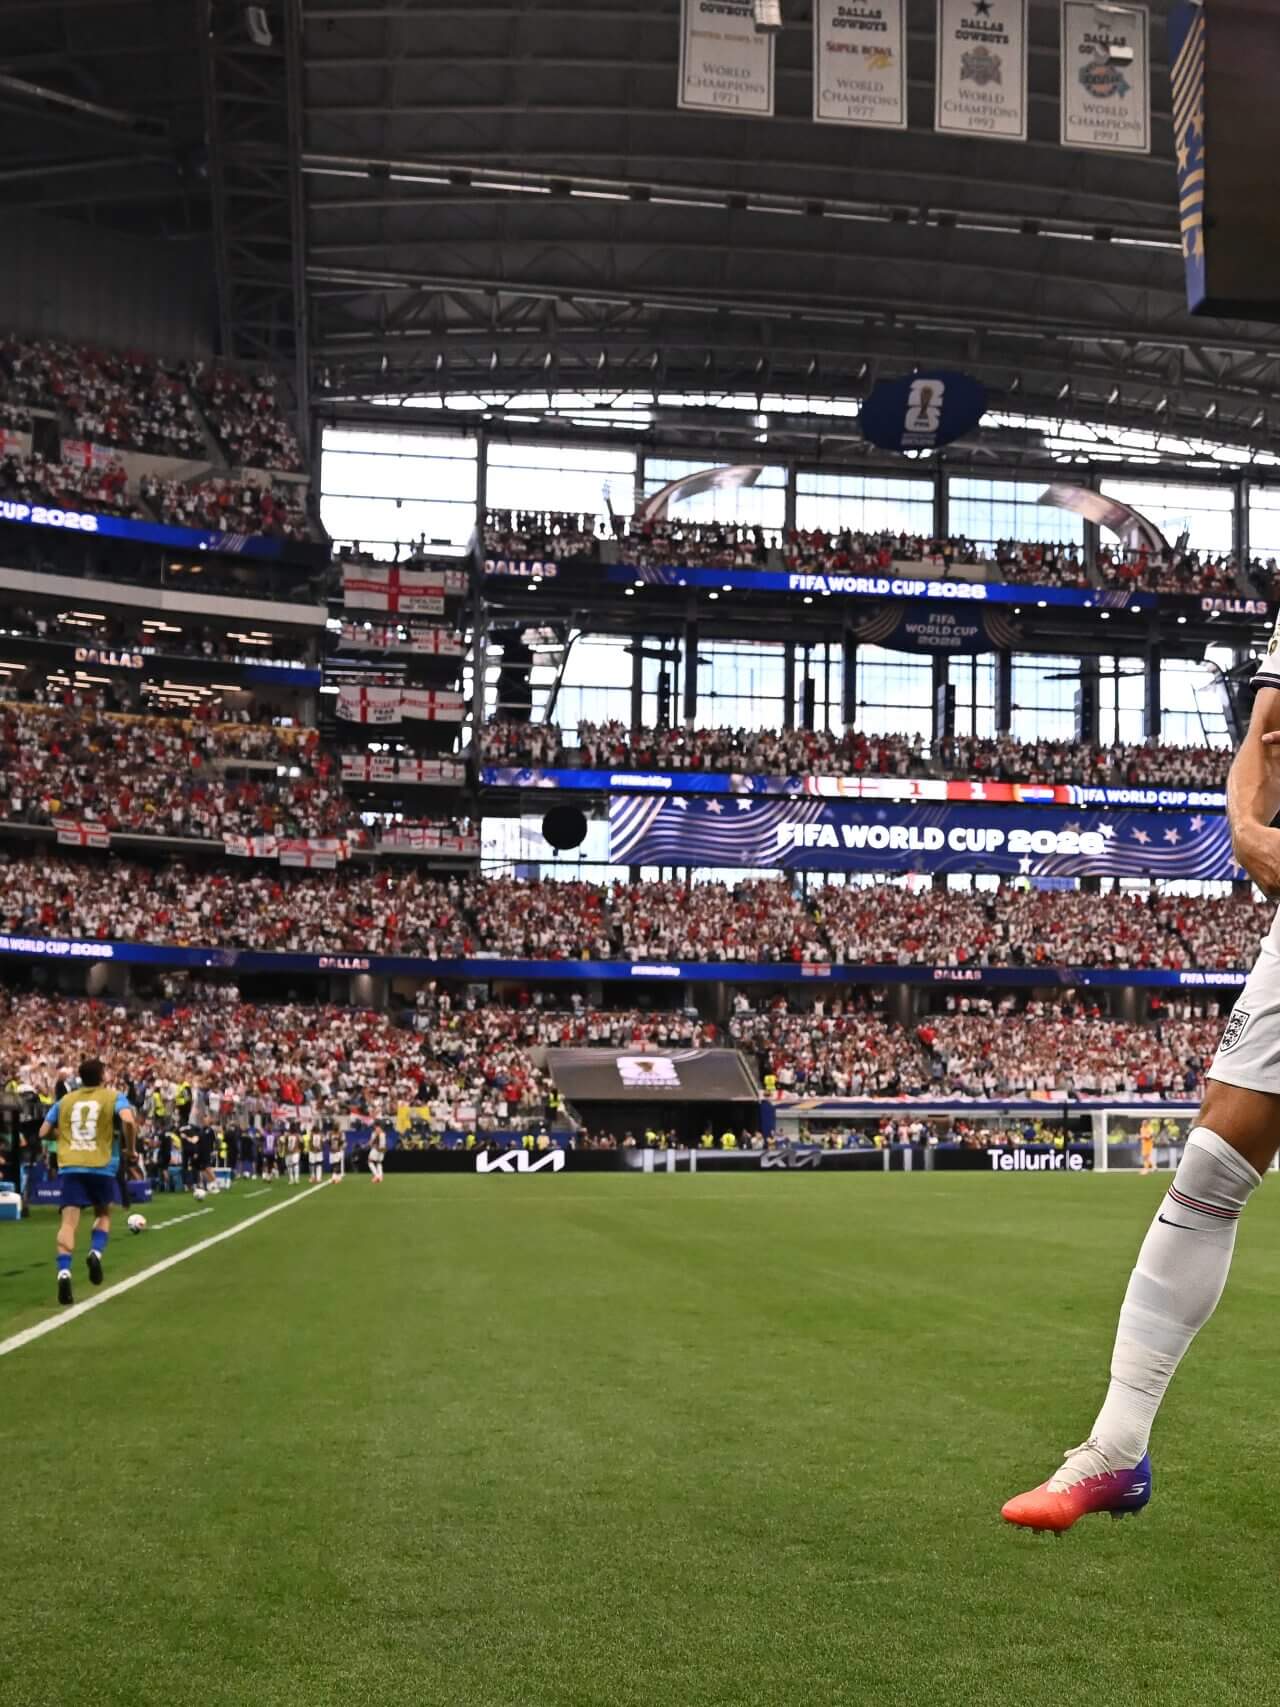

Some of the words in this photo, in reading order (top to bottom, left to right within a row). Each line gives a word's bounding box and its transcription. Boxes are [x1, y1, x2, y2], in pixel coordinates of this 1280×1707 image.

[837, 6, 883, 19] DALLAS
[831, 18, 888, 32] COWBOYS
[960, 19, 1004, 32] DALLAS
[955, 29, 1009, 44] COWBOYS
[1083, 33, 1127, 46] DALLAS
[31, 506, 99, 532] 2026
[485, 559, 557, 577] DALLAS
[788, 574, 828, 591] FIFA
[828, 576, 890, 594] WORLD
[891, 580, 926, 596] CUP
[927, 582, 987, 600] 2026
[1201, 598, 1269, 615] DALLAS
[929, 613, 956, 625] FIFA
[905, 623, 951, 636] WORLD
[953, 625, 979, 637] CUP
[74, 647, 144, 669] DALLAS
[970, 782, 987, 800] 1
[1106, 789, 1158, 803] WORLD
[1158, 792, 1187, 805] CUP
[1187, 792, 1227, 806] 202
[777, 822, 839, 848] FIFA
[841, 826, 945, 850] WORLD
[948, 828, 1005, 852] CUP
[1007, 830, 1105, 855] 2026
[9, 937, 45, 953] WORLD
[46, 940, 70, 954] CUP
[70, 942, 113, 958] 2026
[319, 956, 370, 970] DALLAS
[933, 968, 982, 981] DALLAS
[1180, 973, 1204, 984] FIFA
[1204, 973, 1246, 985] WORLD
[476, 1150, 565, 1172] KIA
[987, 1149, 1083, 1171] Telluride
